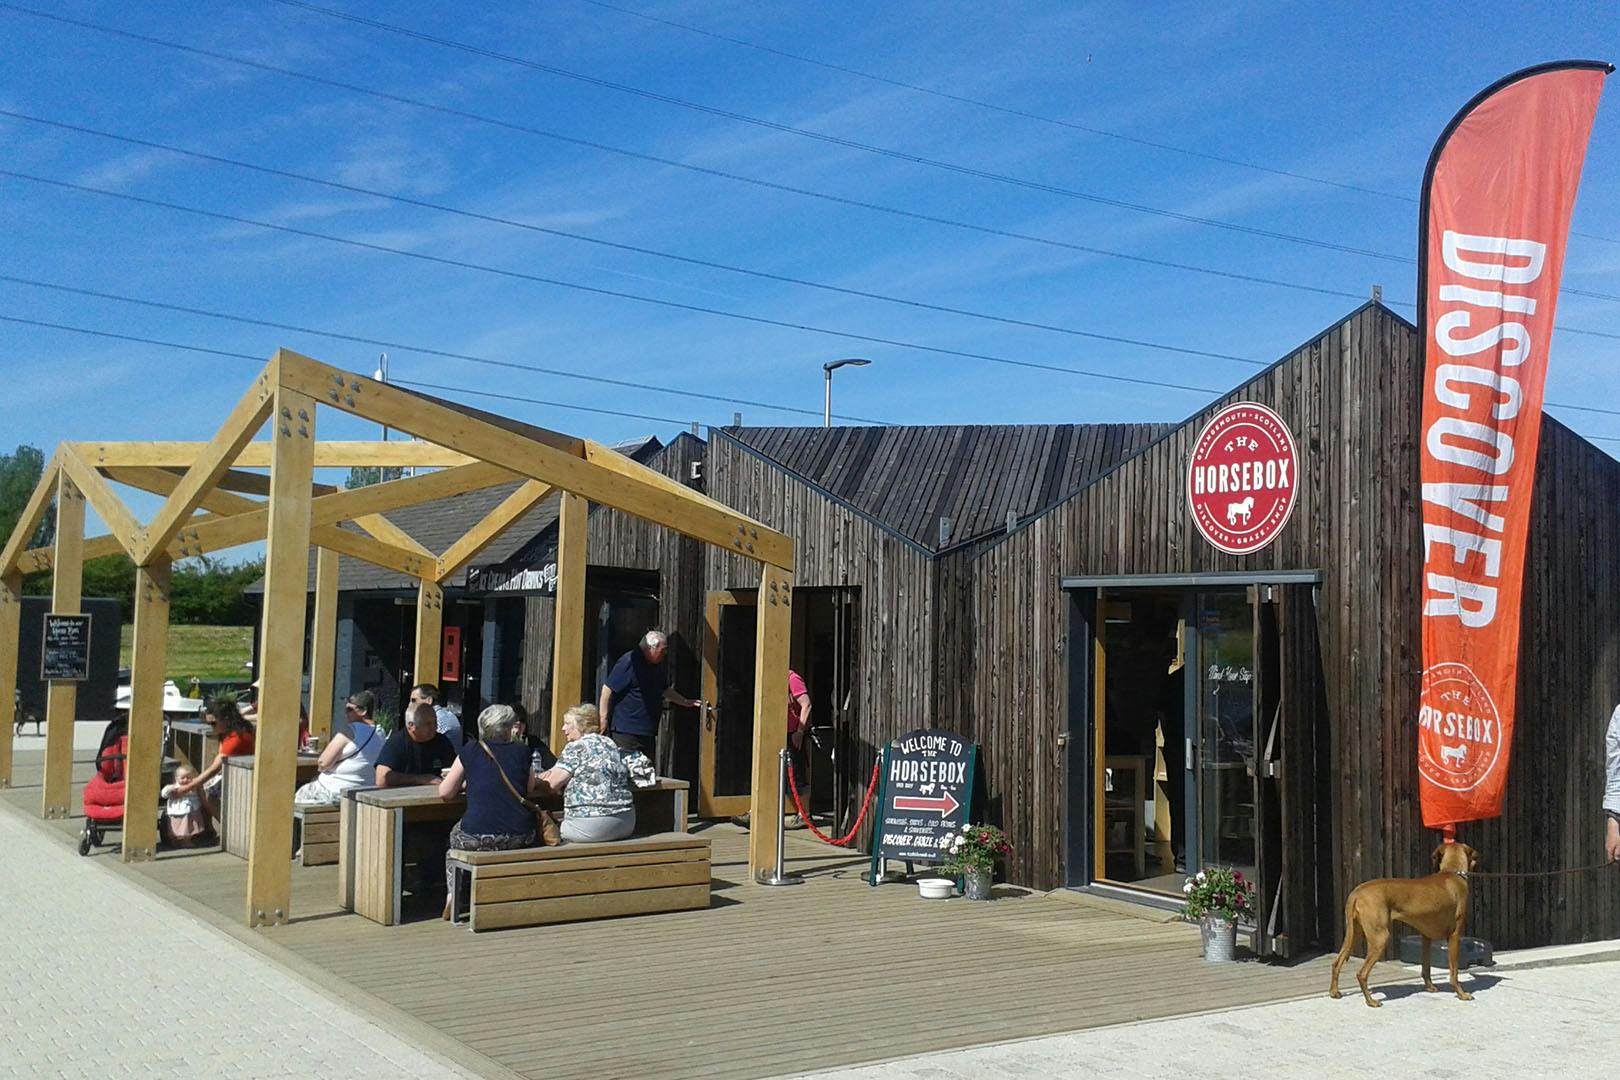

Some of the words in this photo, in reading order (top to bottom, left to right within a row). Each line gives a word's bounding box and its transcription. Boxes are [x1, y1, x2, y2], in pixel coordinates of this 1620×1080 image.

[1197, 412, 1247, 460] GRANGEMOUTH
[1254, 414, 1288, 452] SCOTLAND
[1422, 230, 1546, 628] DISCOVER
[1224, 436, 1259, 453] THE
[1194, 458, 1290, 495] HORSEBOX
[1197, 503, 1229, 543] DISCOVER
[1236, 529, 1266, 545] GRAZE
[1271, 497, 1287, 525] SHOP
[1441, 690, 1471, 706] THE
[900, 735, 948, 755] WELCOME
[949, 739, 962, 757] TO
[921, 750, 938, 758] THE
[890, 760, 966, 784] HORSEBOX
